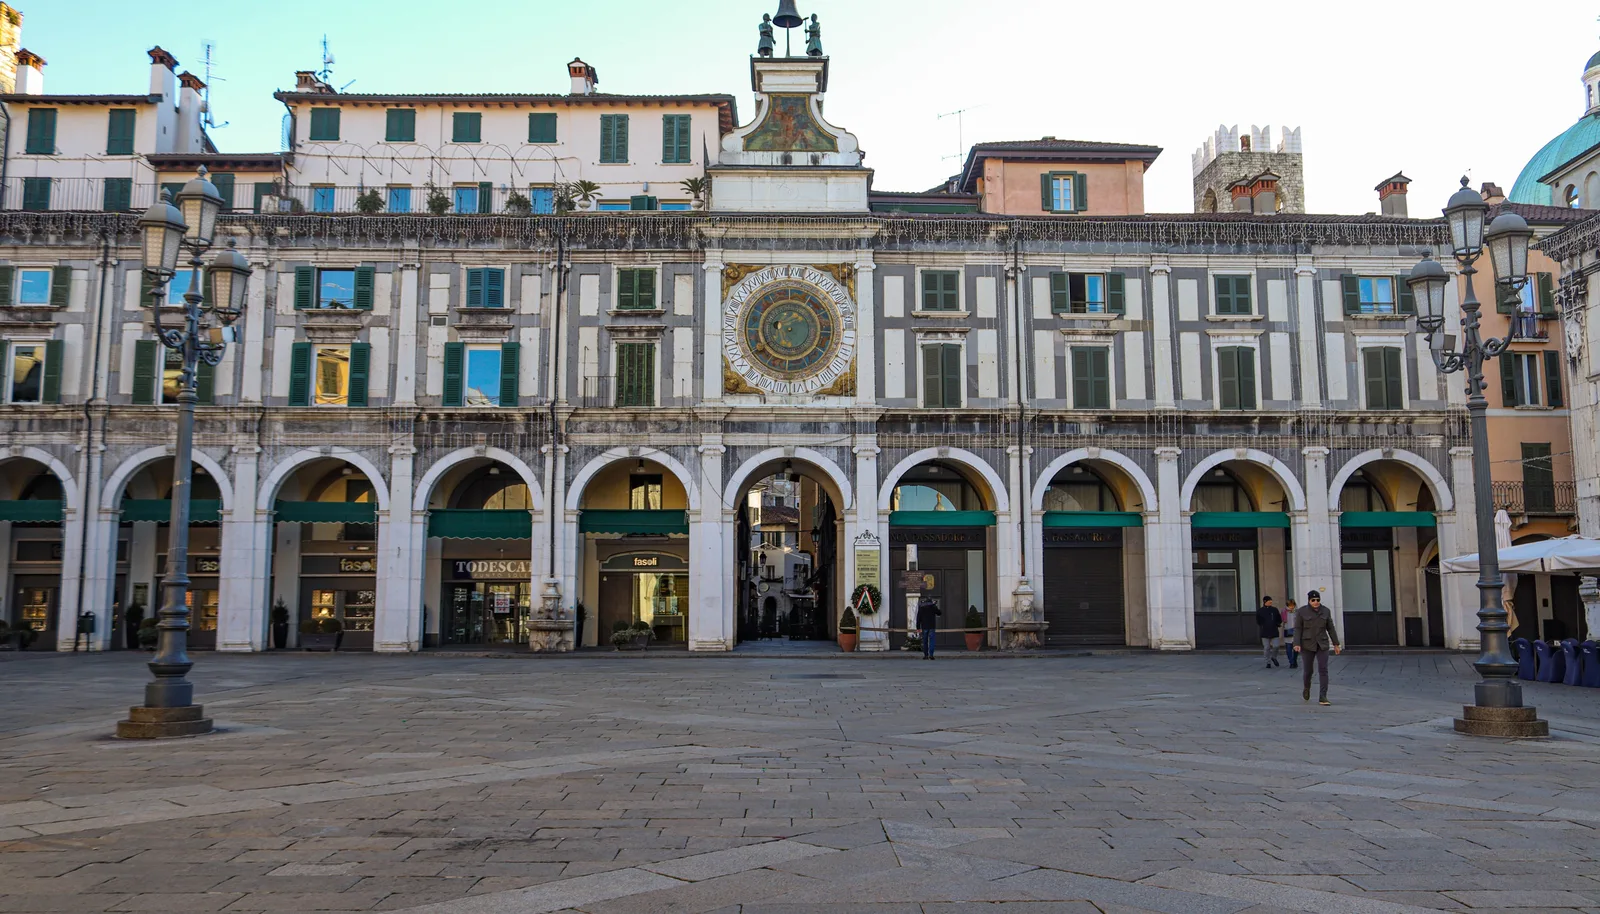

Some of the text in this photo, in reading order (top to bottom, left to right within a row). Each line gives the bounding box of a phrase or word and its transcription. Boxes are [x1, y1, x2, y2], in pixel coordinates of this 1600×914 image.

[806, 270, 819, 282] XX
[819, 277, 833, 291] XXI
[735, 286, 748, 301] XV
[725, 331, 735, 344] XII
[728, 347, 741, 359] XI
[839, 347, 850, 357] II
[736, 360, 748, 371] X
[832, 359, 843, 372] III
[820, 369, 833, 383] IIII
[775, 382, 788, 393] VII
[793, 383, 804, 393] VI
[811, 380, 818, 389] V
[634, 557, 657, 566] fasoli
